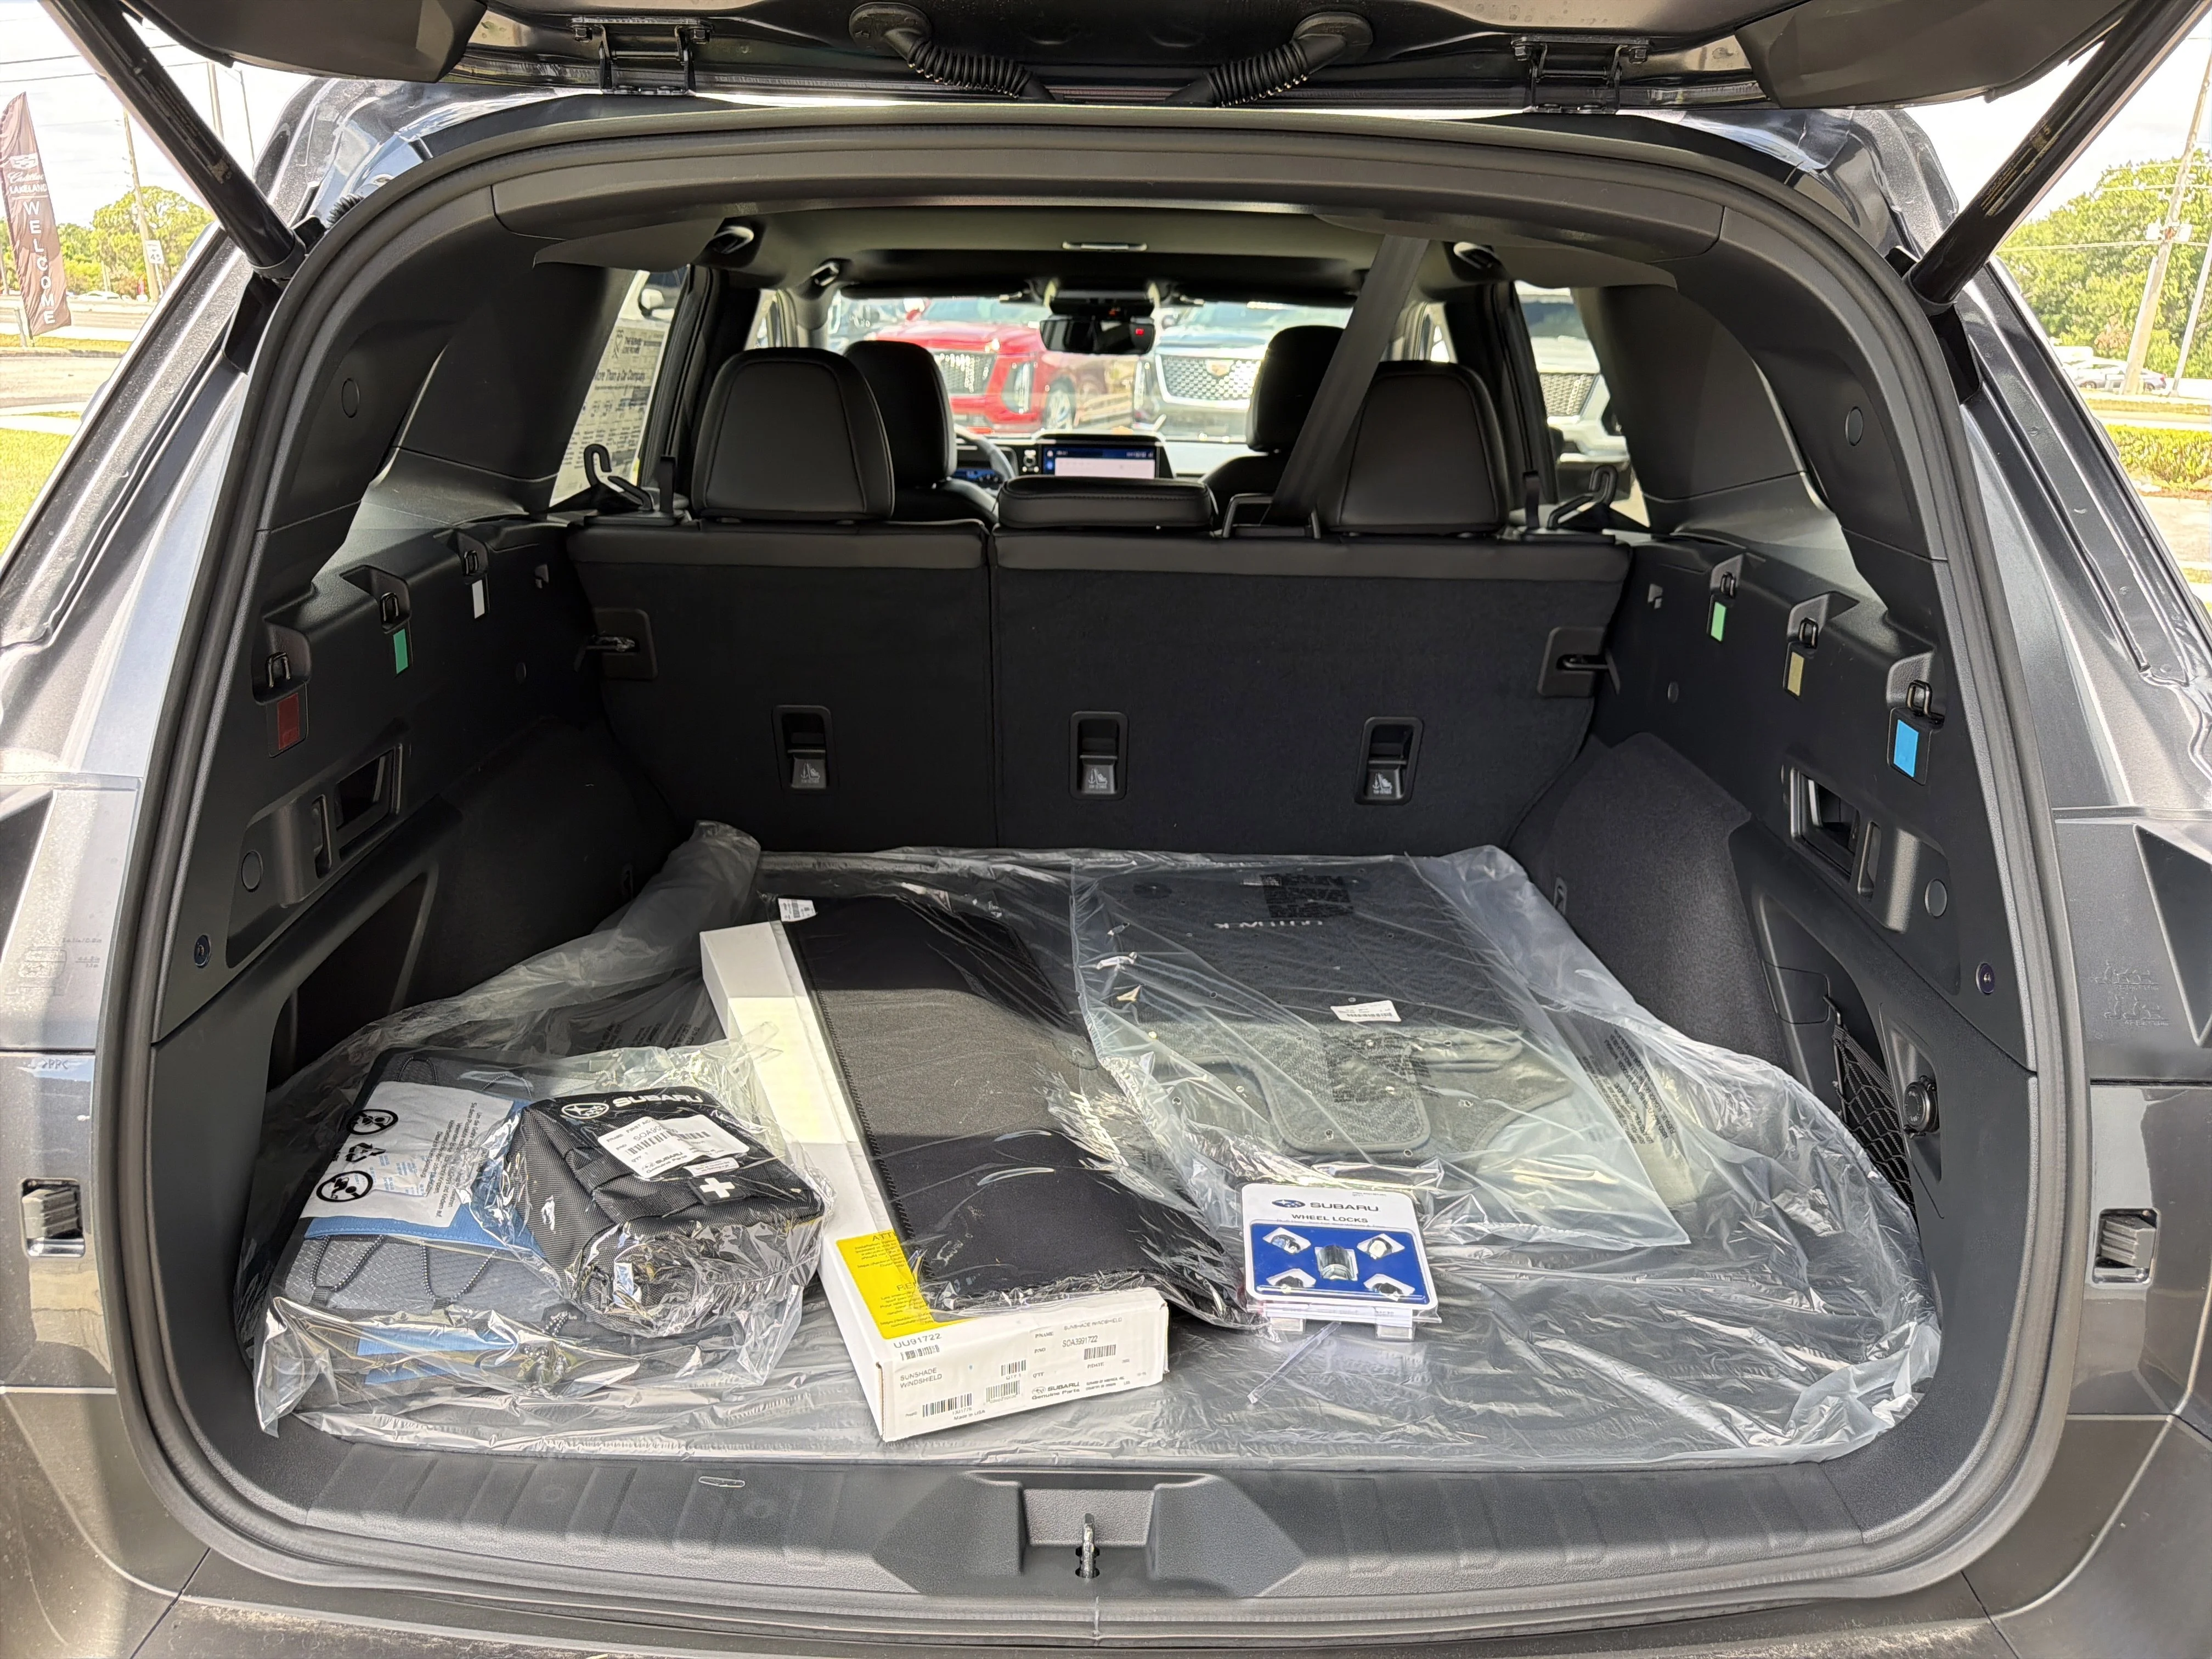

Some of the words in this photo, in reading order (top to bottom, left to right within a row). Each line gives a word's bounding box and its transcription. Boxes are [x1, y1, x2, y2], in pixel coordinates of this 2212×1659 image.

[9, 183, 48, 194] LAKELAND
[22, 201, 55, 324] WELCOME
[612, 1094, 704, 1108] SUBARU
[1070, 1091, 1130, 1167] SUBARU
[655, 1152, 683, 1164] SUBARU
[1310, 1201, 1379, 1212] SUBARU
[1333, 1215, 1369, 1223] LOCKS
[893, 1333, 943, 1349] UU91722
[900, 1367, 938, 1381] SUNSHADE
[900, 1373, 943, 1389] WINDSHIELD
[1047, 1381, 1080, 1392] SUBARU
[1031, 1391, 1060, 1400] Genuine
